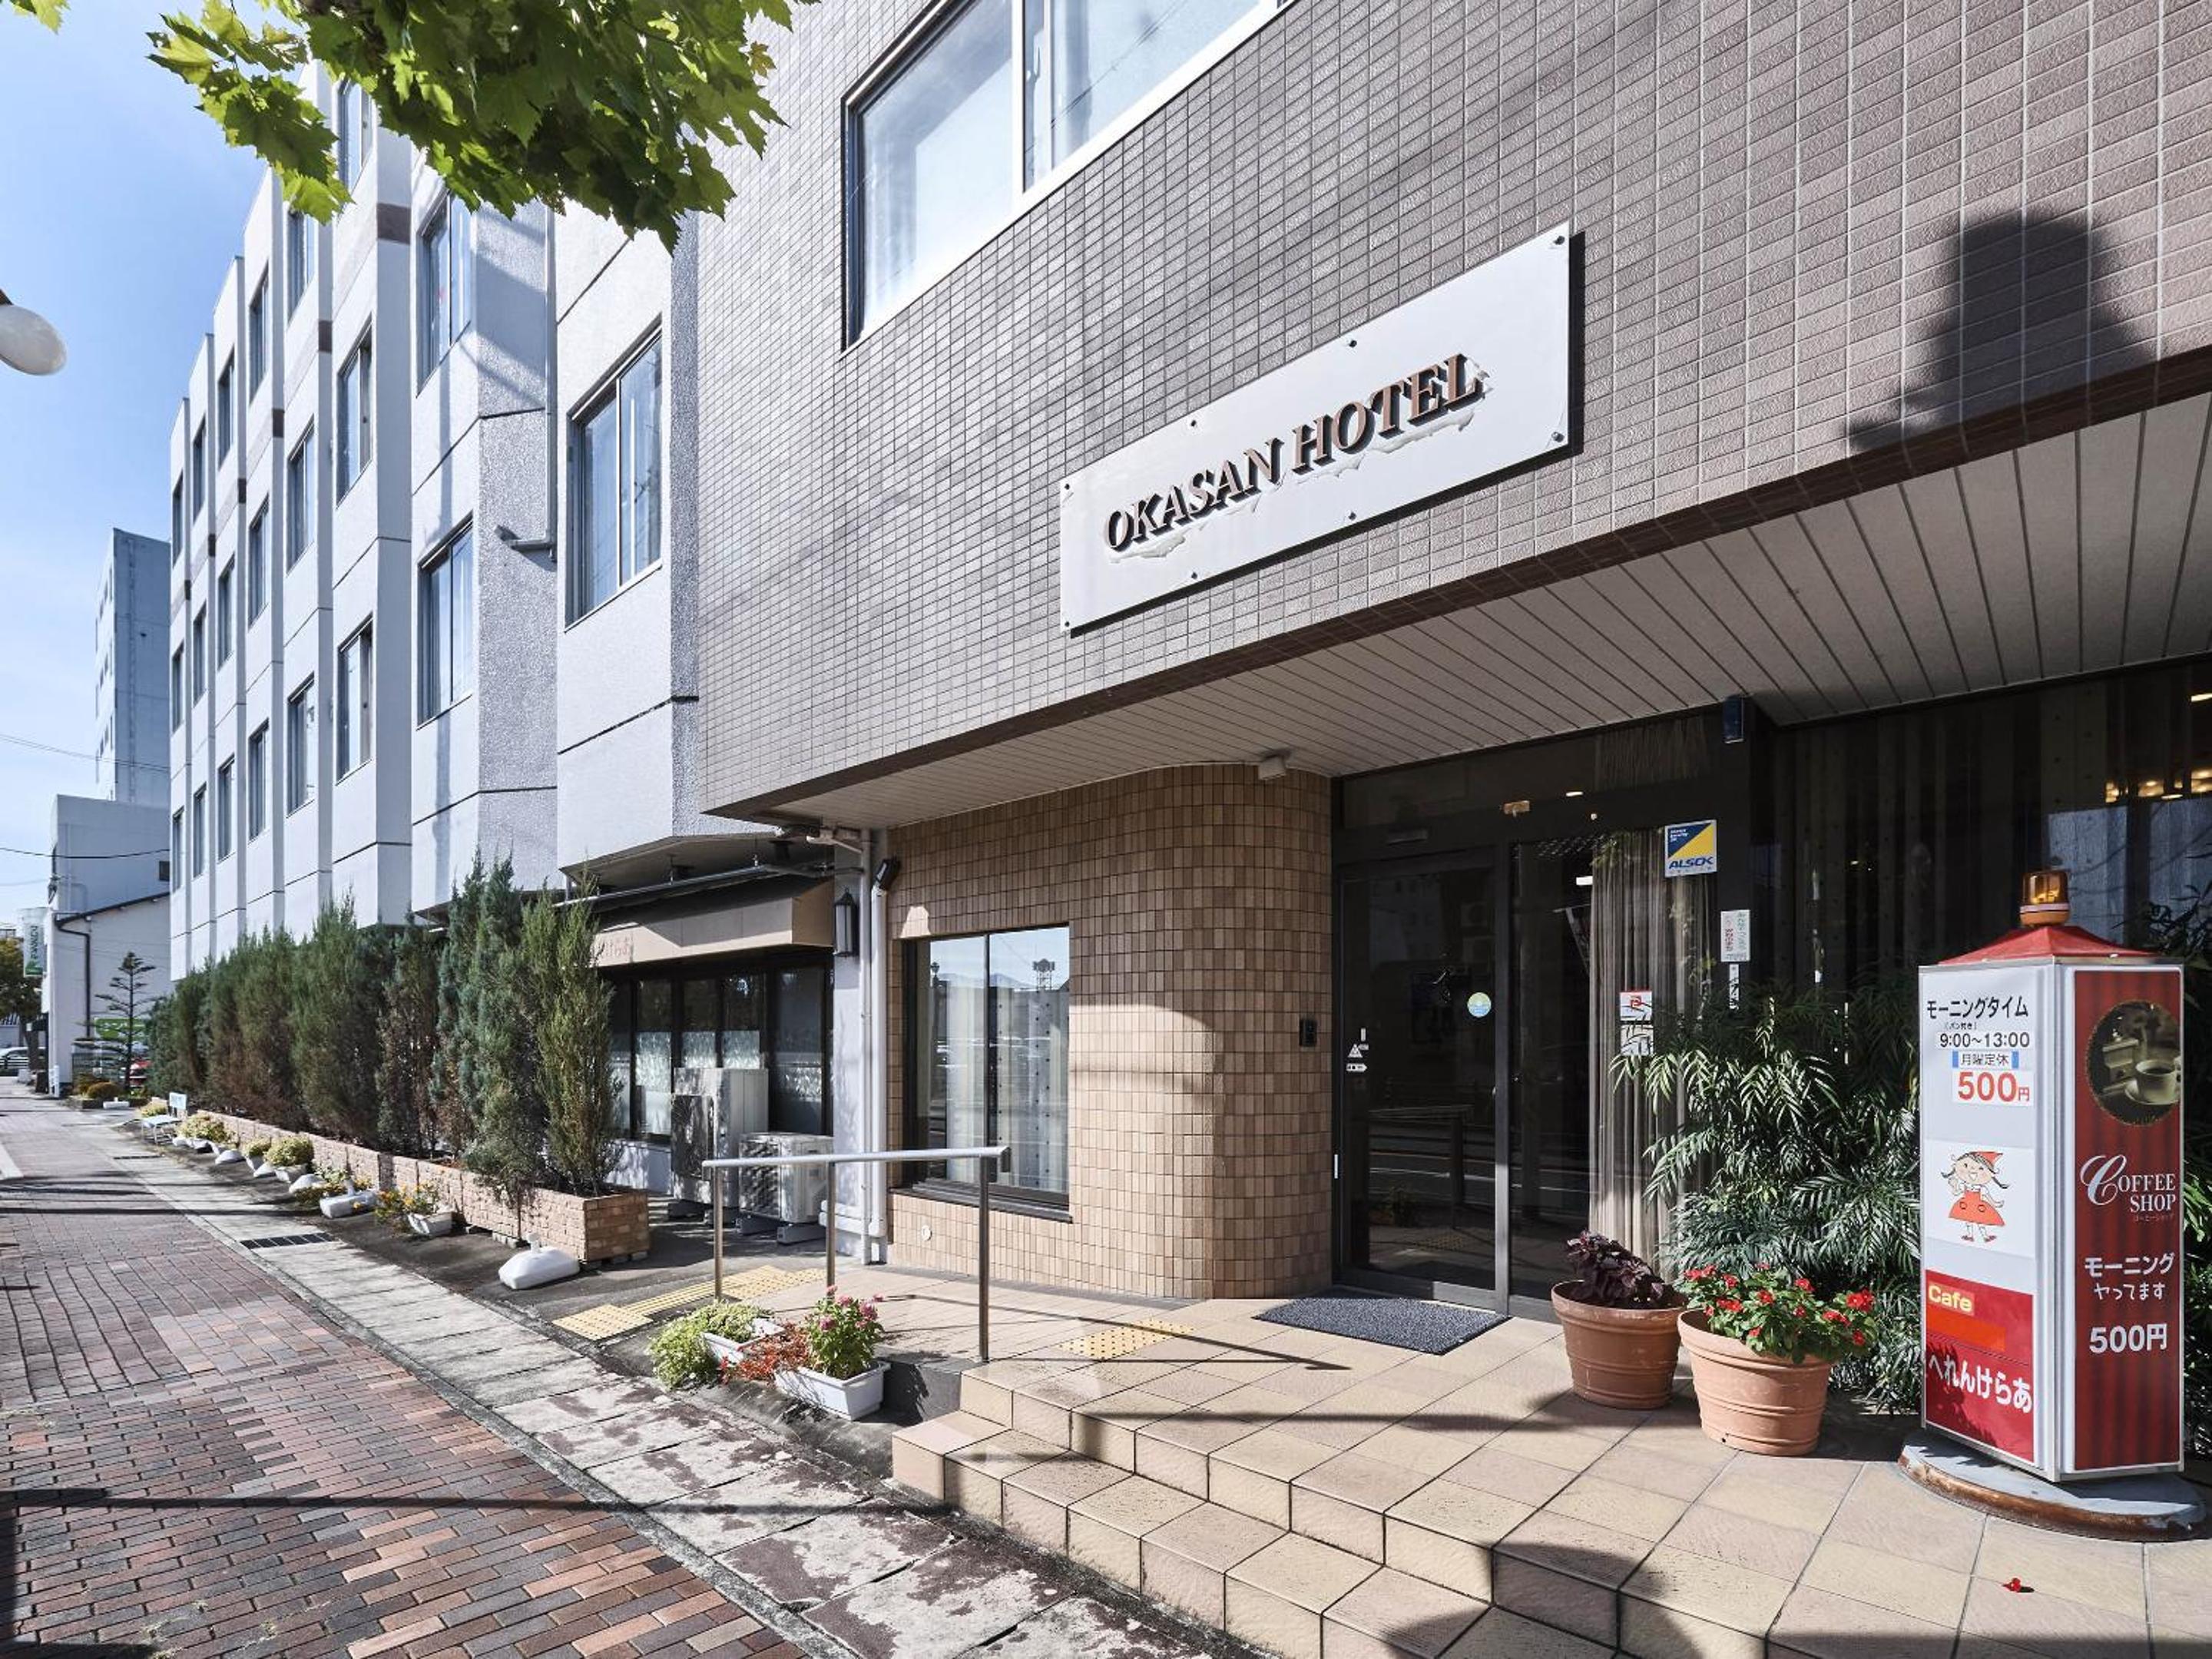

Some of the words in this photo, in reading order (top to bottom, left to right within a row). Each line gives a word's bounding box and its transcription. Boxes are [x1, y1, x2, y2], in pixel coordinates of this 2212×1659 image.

[1104, 437, 1284, 552] OKASAN
[1291, 353, 1484, 475] HOTEL
[1668, 856, 1714, 869] ALSOK
[1927, 996, 2028, 1019] モーニングタイム
[1961, 1053, 2009, 1066] 月曜定休
[1958, 1071, 2030, 1102] 500円
[2080, 1154, 2176, 1205] COFFEE
[2130, 1194, 2176, 1213] SHOP
[2085, 1252, 2175, 1277] モーニング
[1929, 1285, 1973, 1313] Cafe
[2089, 1323, 2167, 1354] 500円
[1929, 1354, 2032, 1413] へれんけらあ
